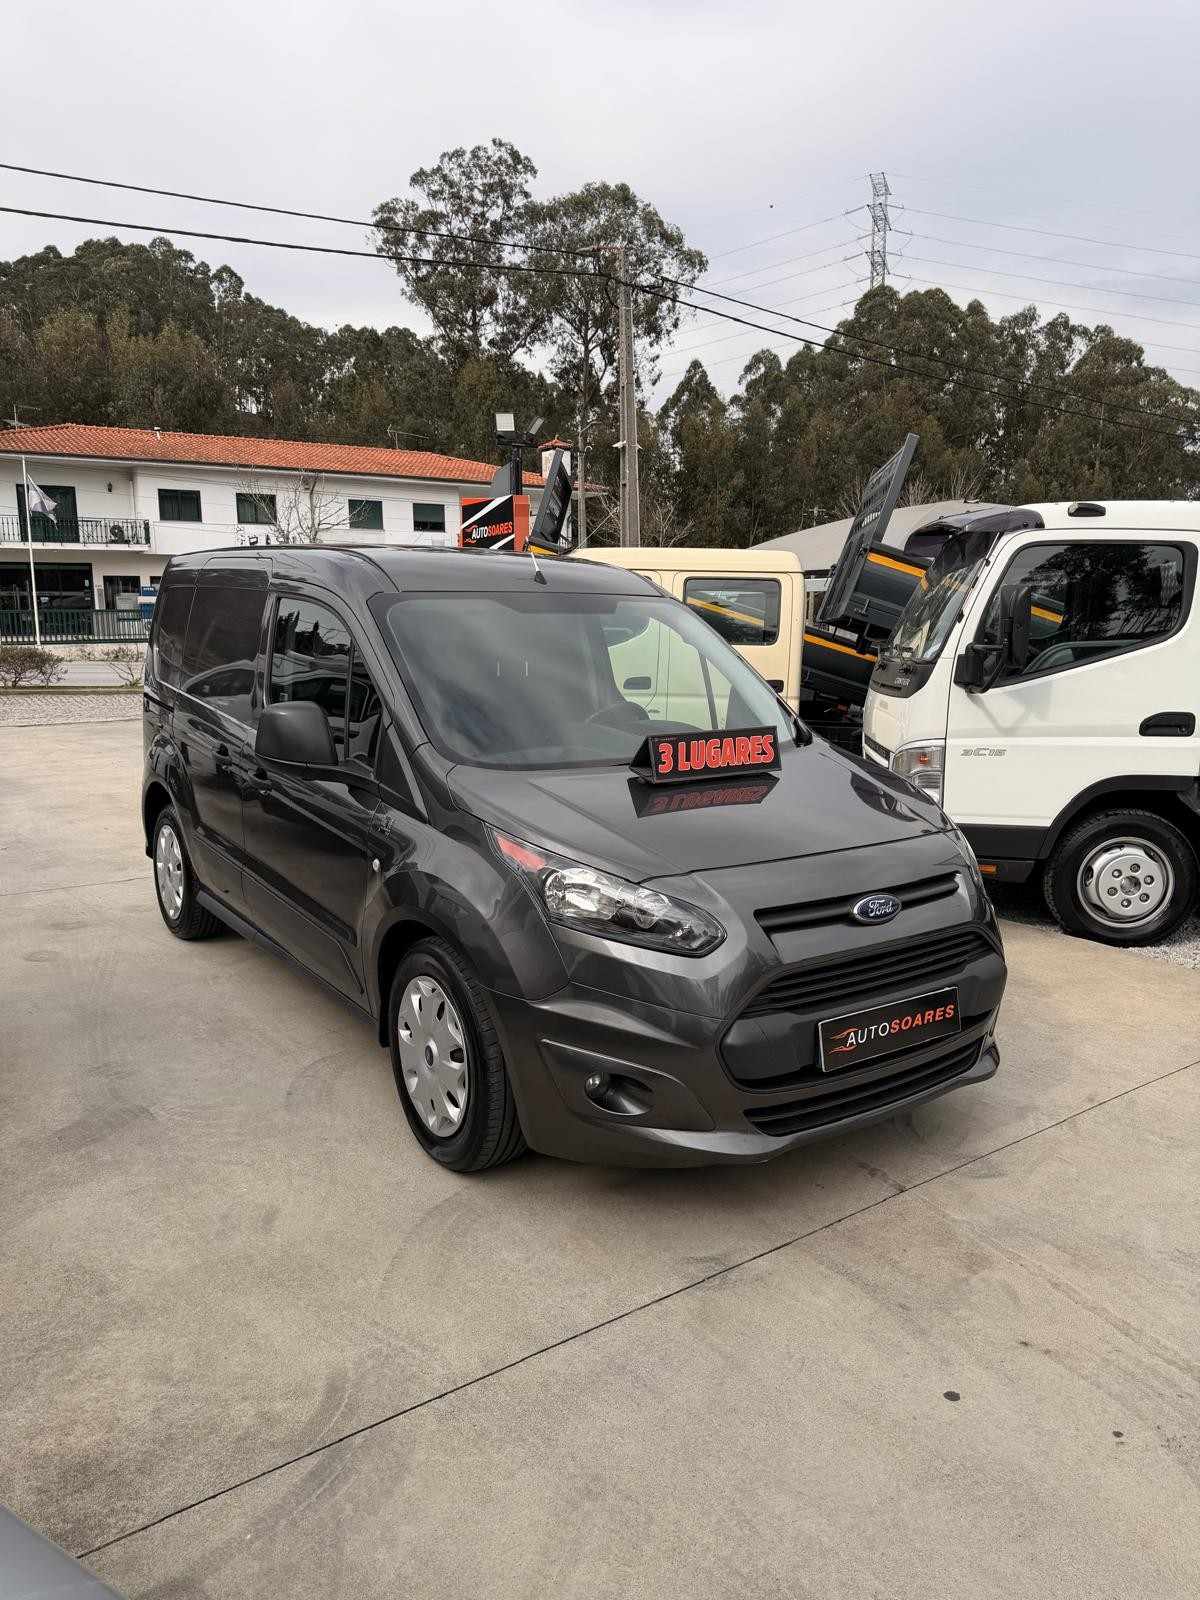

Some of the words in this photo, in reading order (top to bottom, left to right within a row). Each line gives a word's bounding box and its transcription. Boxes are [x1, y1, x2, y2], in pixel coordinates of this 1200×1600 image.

[471, 521, 513, 539] AUTOSOARES
[658, 742, 674, 773] 3
[678, 734, 775, 771] LUGARES
[868, 899, 894, 917] Ford
[846, 1004, 955, 1047] AUTOSOARES
